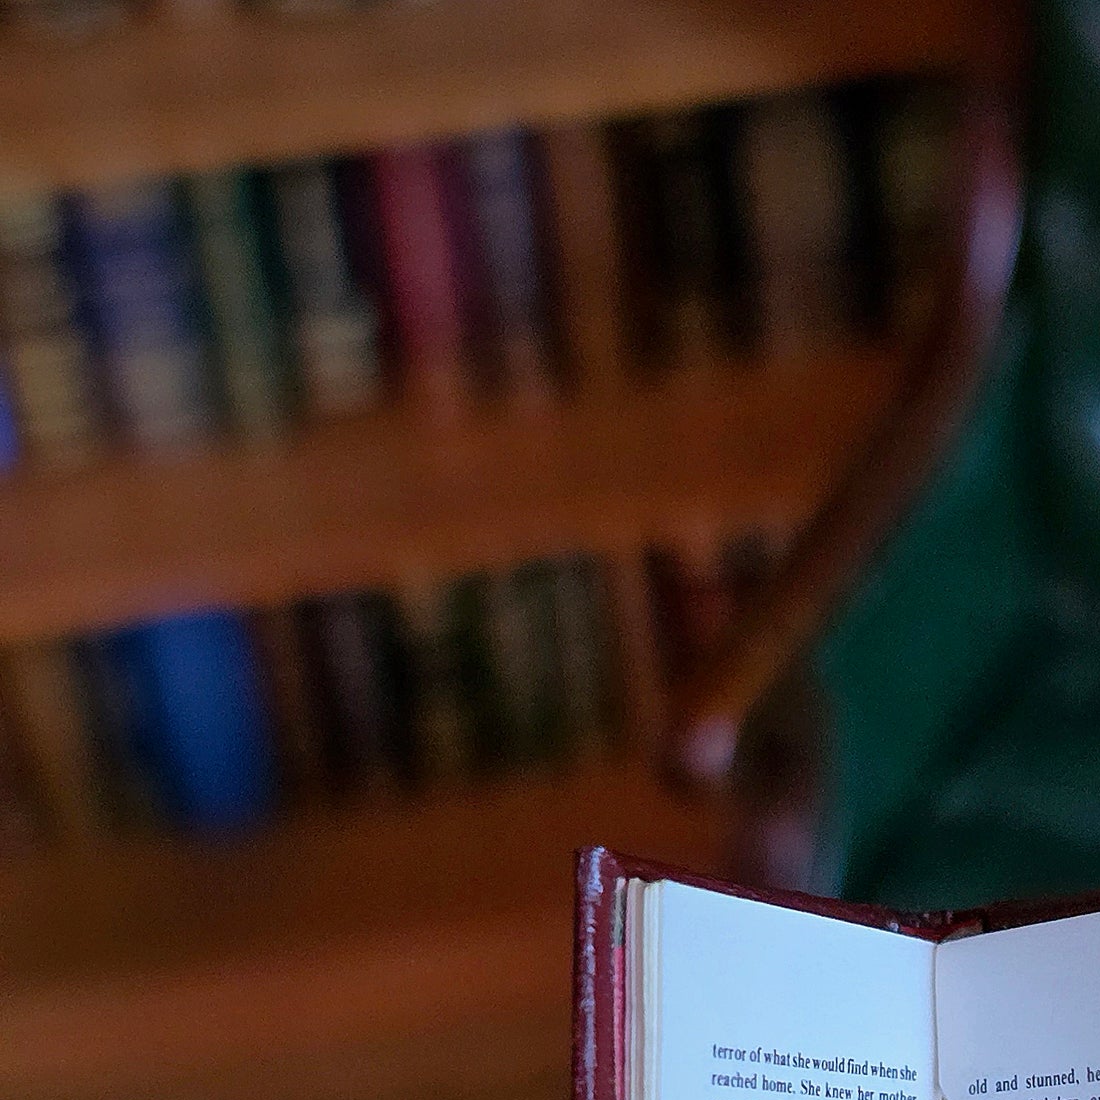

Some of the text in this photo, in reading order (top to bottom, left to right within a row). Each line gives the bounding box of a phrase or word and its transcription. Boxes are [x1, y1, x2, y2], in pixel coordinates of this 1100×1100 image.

[712, 1044, 917, 1081] terror of what she would find when she
[711, 1072, 757, 1089] reached
[762, 1075, 796, 1094] home.
[800, 1079, 821, 1097] She
[825, 1082, 853, 1100] knew
[968, 1078, 988, 1096] old
[995, 1075, 1018, 1093] and
[1025, 1068, 1080, 1089] stunned,
